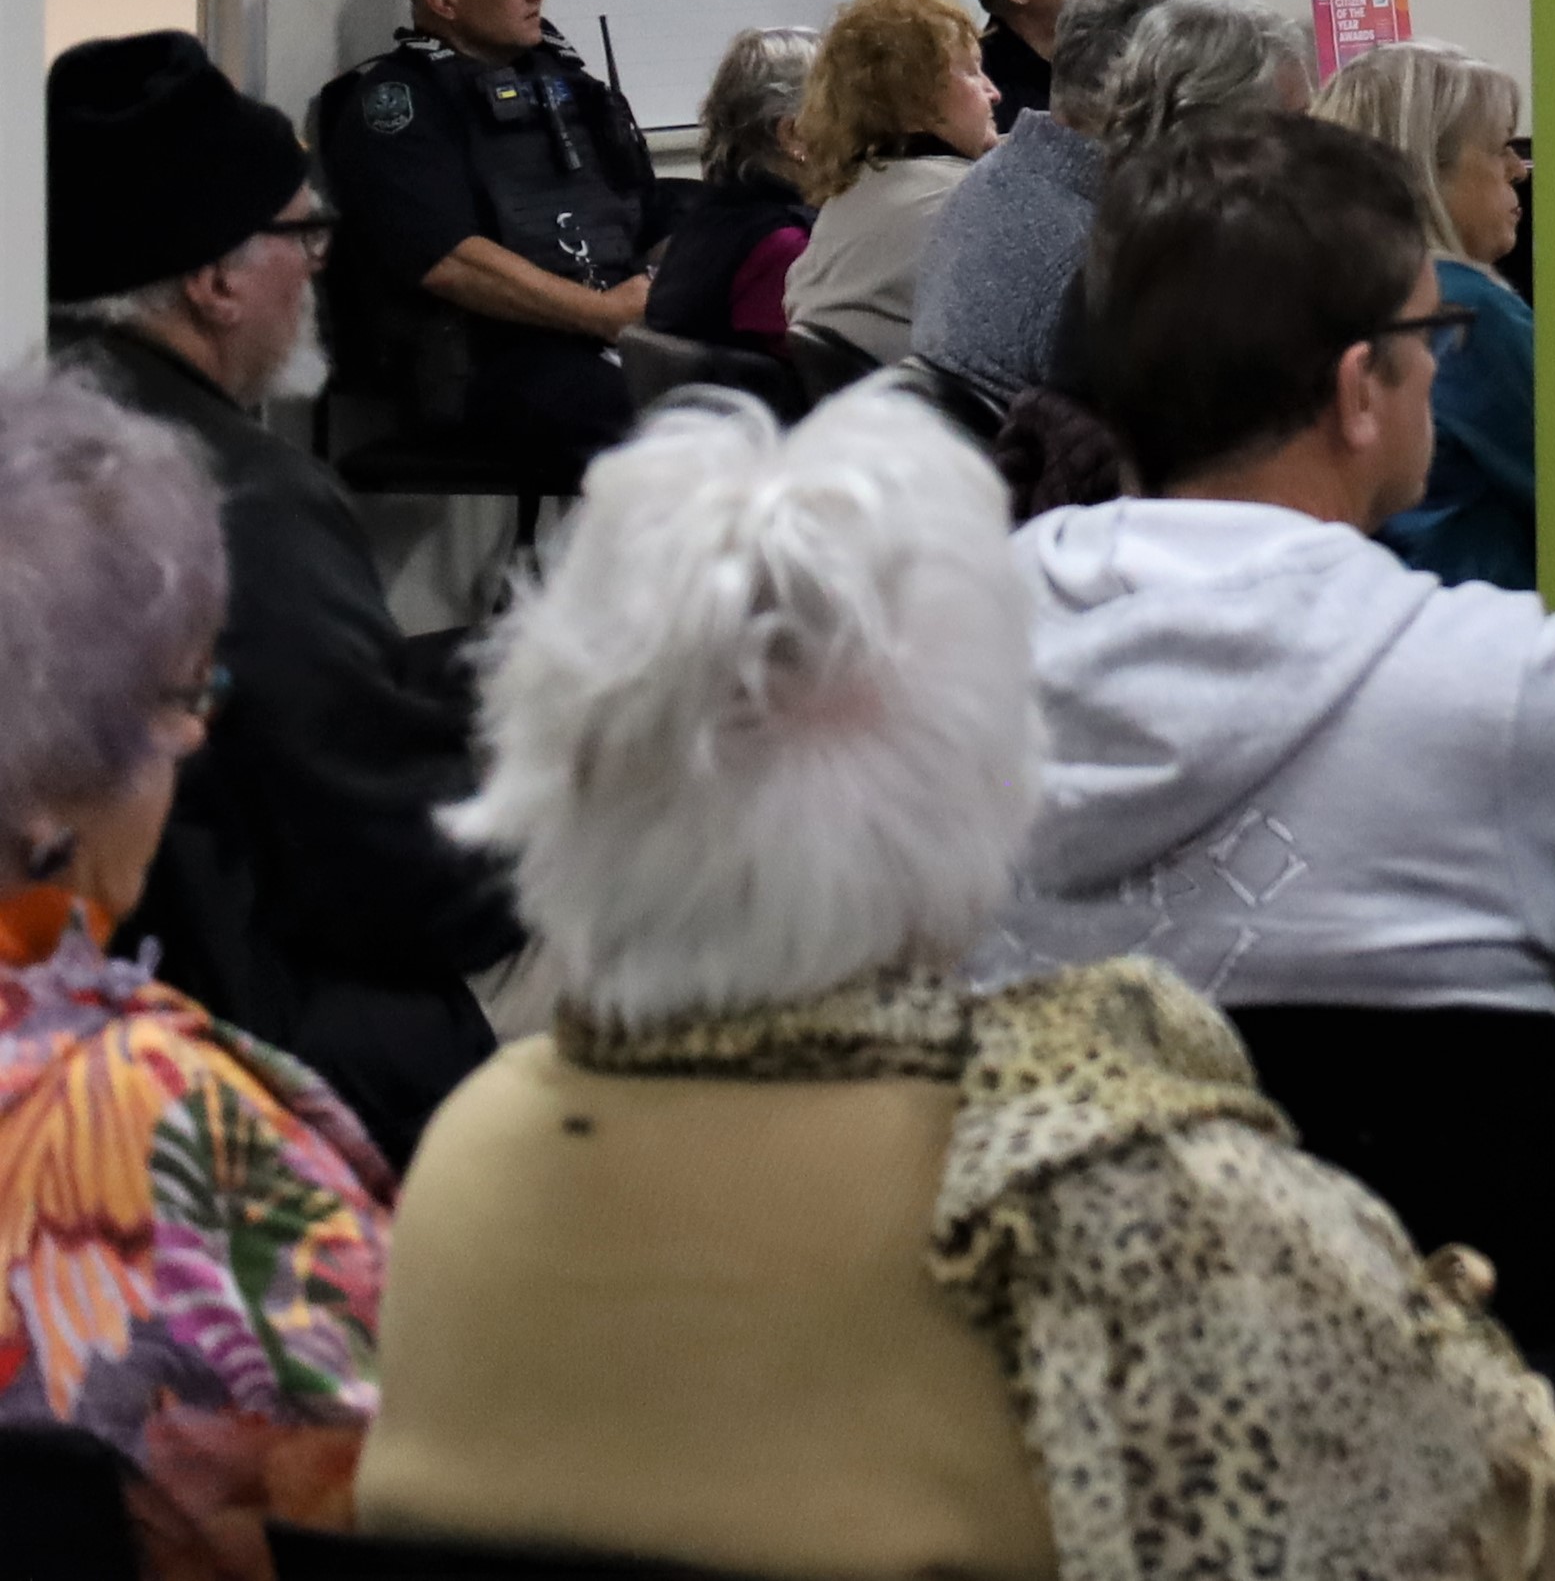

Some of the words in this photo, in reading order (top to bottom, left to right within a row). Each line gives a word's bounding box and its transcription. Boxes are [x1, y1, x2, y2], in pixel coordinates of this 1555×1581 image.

[1336, 8, 1348, 18] OF
[1350, 7, 1366, 18] THE
[1337, 19, 1359, 30] YEAR
[1339, 29, 1375, 42] AWARDS
